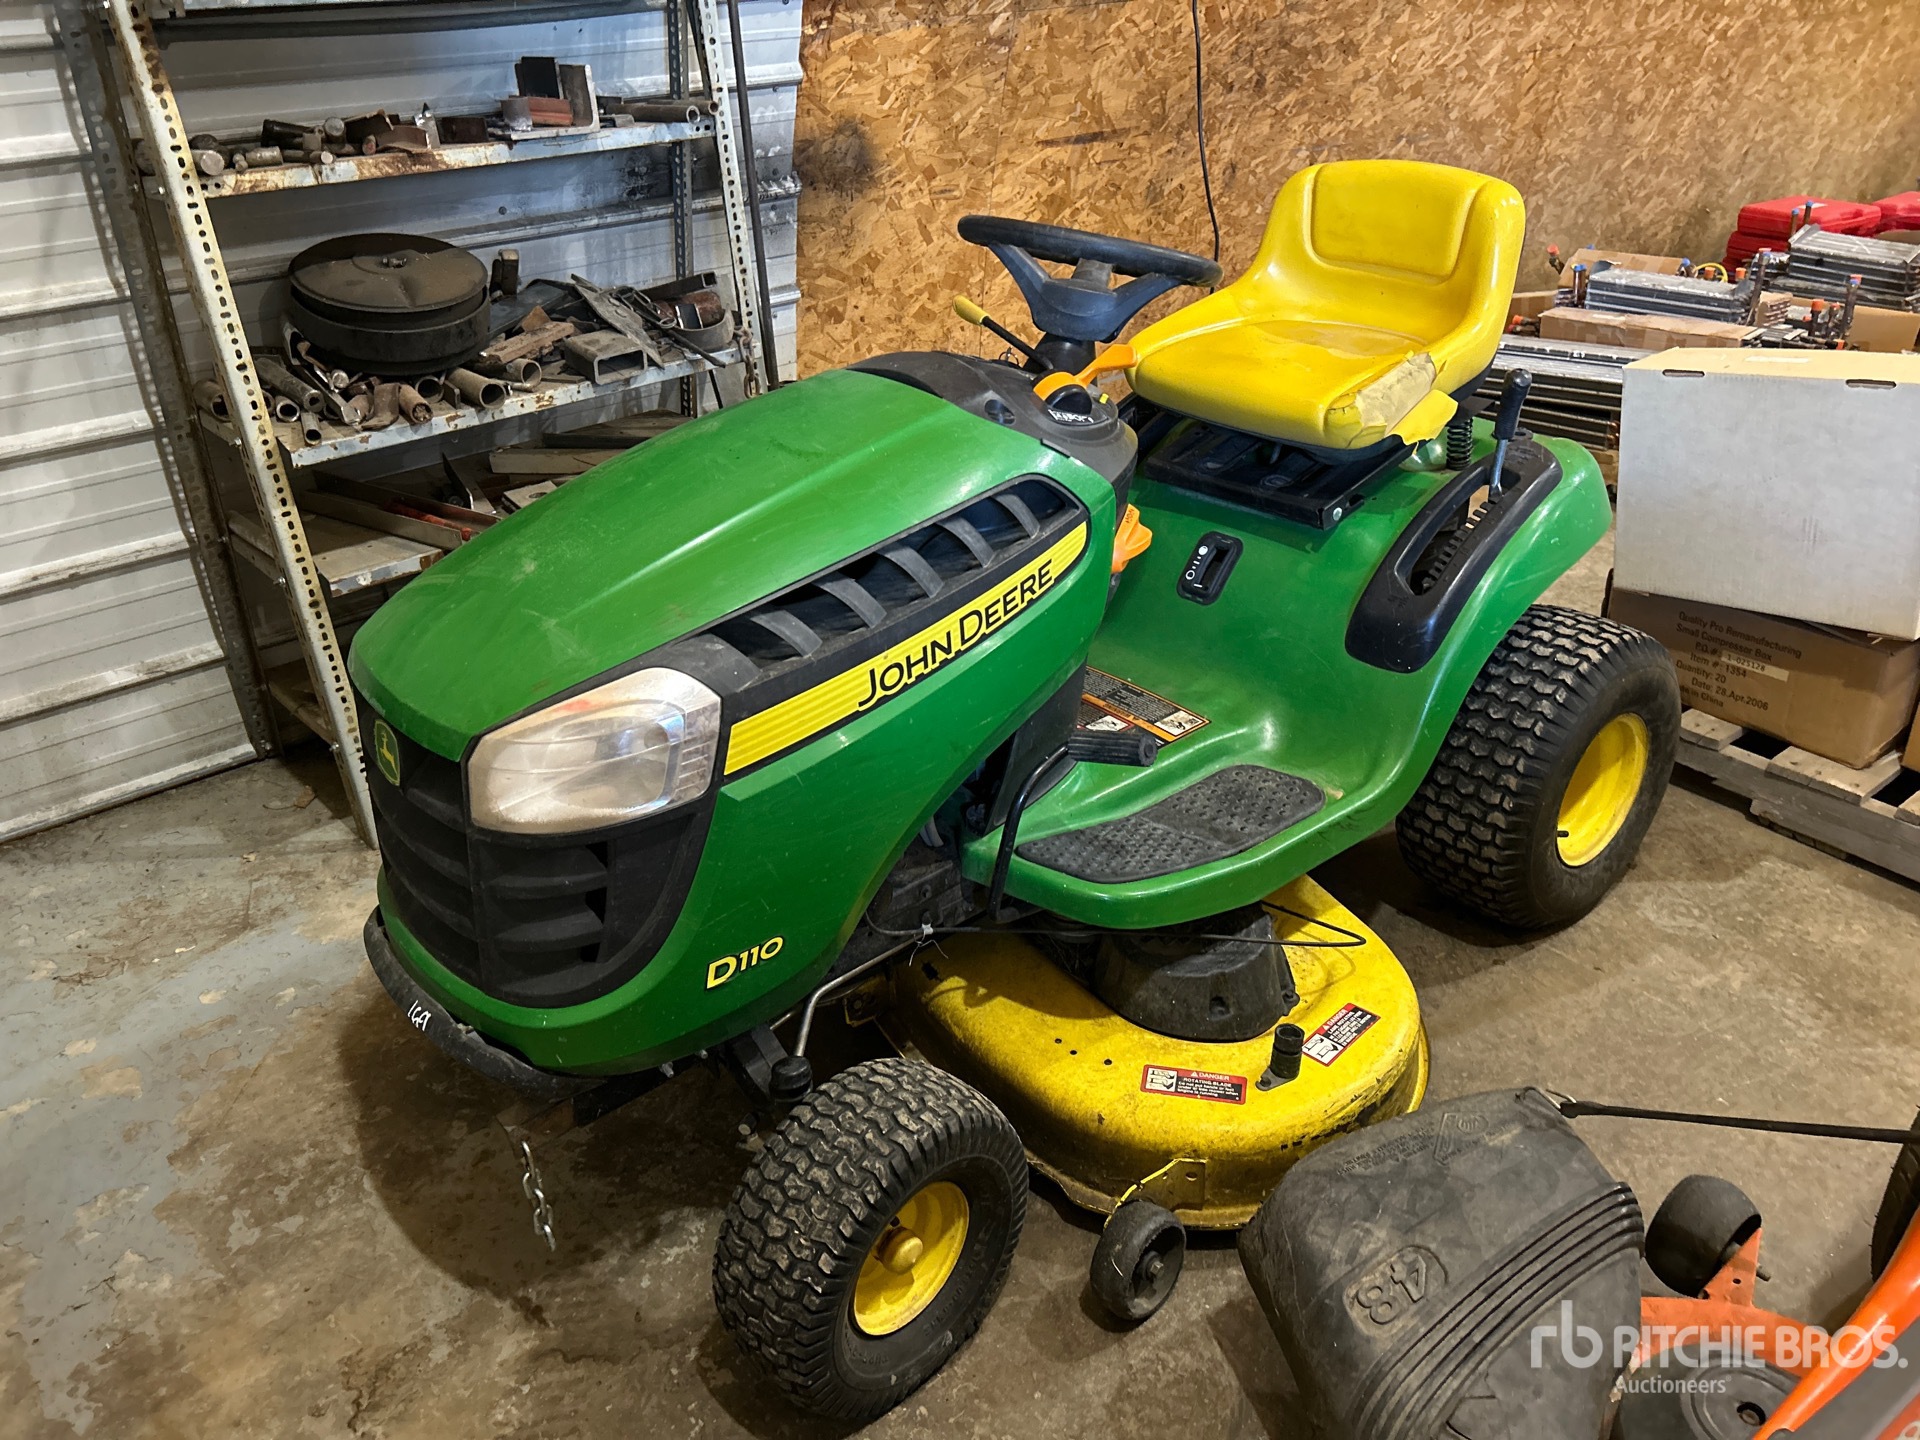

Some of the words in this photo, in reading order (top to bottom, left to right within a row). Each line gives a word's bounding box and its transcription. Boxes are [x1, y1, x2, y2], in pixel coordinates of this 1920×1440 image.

[858, 630, 953, 708] JOHN
[959, 559, 1053, 645] DEERE
[1676, 623, 1700, 638] Small
[1701, 631, 1753, 654] Compressor
[1754, 649, 1773, 661] Box
[1678, 611, 1708, 628] Quality
[1709, 620, 1725, 633] Pro
[1725, 626, 1802, 659] Remanufacturing
[1676, 660, 1713, 680] Quantity:
[1714, 673, 1727, 684] 20
[1690, 652, 1710, 665] Item
[1725, 664, 1747, 678] 1354
[1691, 677, 1713, 691] Date:
[1701, 692, 1724, 708] China
[706, 936, 784, 990] D110
[1198, 1072, 1230, 1081] DANGER
